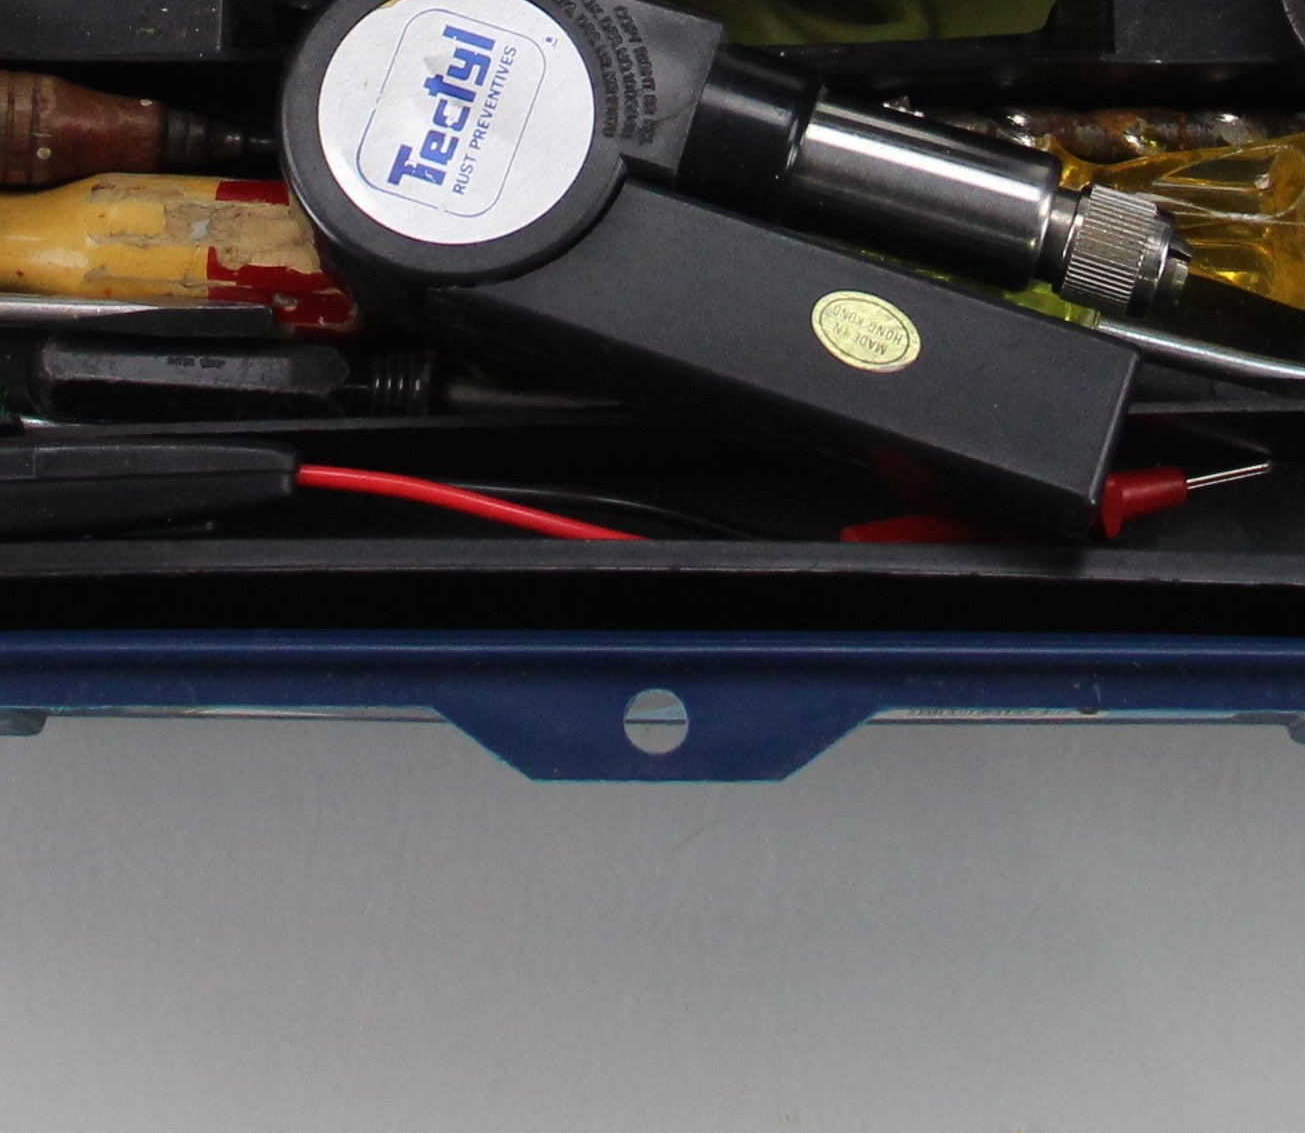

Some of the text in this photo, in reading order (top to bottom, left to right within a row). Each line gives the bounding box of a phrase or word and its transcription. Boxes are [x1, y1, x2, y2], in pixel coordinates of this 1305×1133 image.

[386, 23, 496, 186] Tectyl
[451, 44, 518, 196] RUST PREVENTIVES
[832, 304, 903, 346] HONG KONG
[852, 331, 888, 356] MADE
